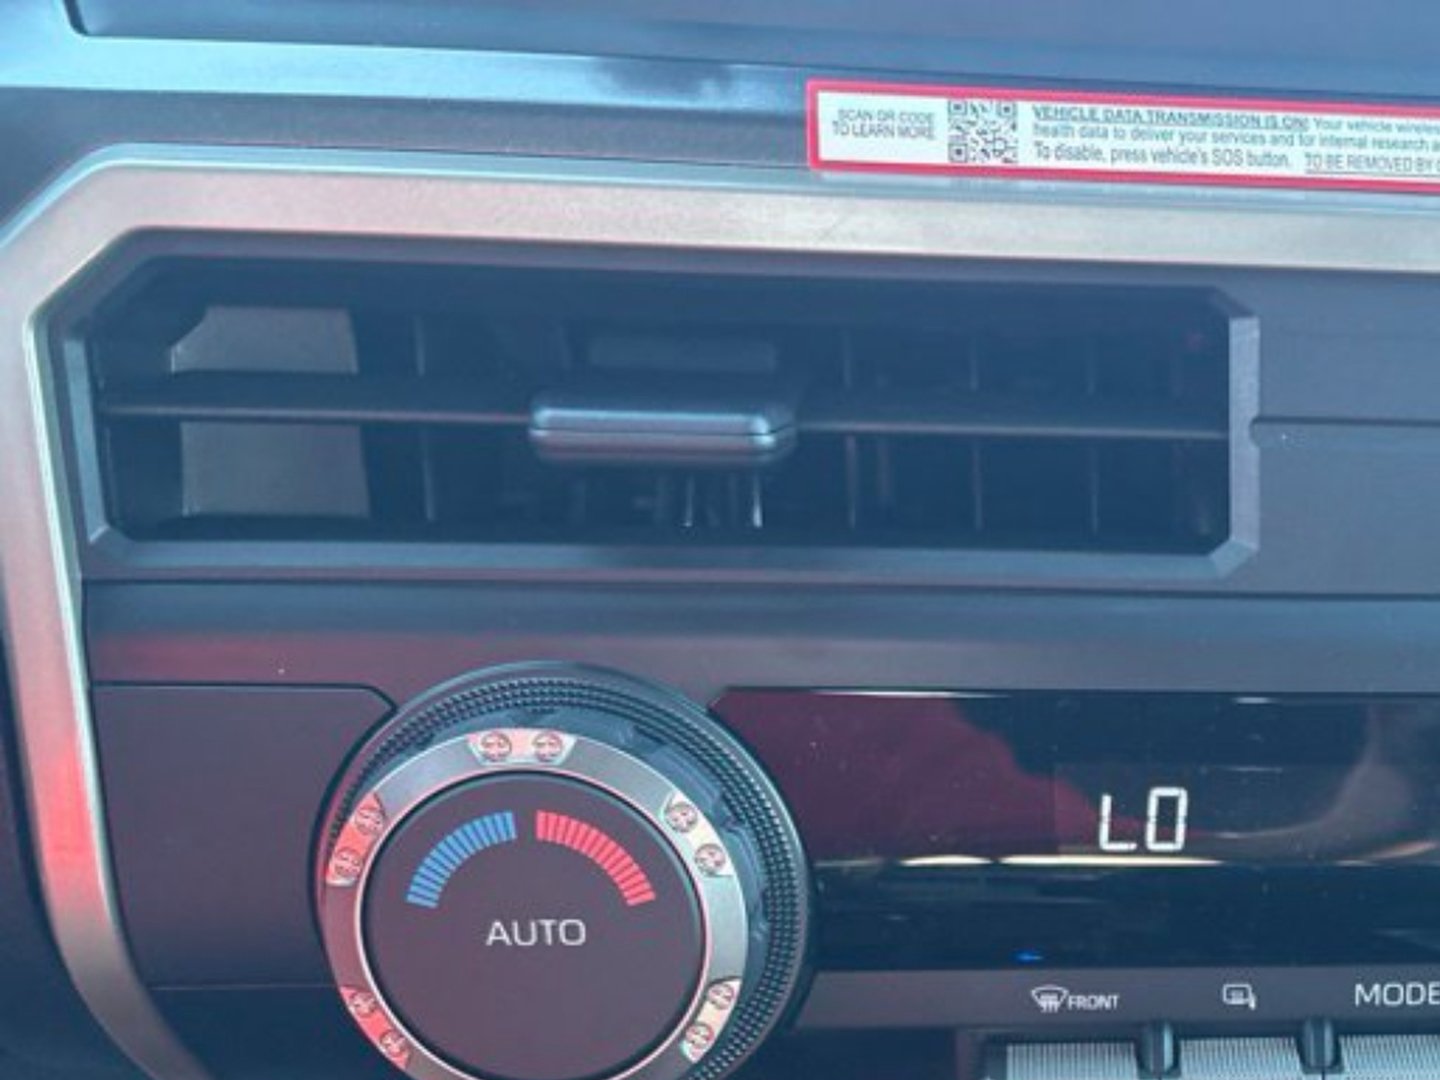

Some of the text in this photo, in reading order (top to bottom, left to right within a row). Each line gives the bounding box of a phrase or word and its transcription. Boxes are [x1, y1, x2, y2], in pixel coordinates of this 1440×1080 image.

[832, 120, 936, 140] TO LEARN MORE
[1031, 104, 1101, 122] VEHICLE
[1103, 108, 1144, 125] DATA
[1147, 109, 1261, 131] TRANSMISSION
[1263, 115, 1278, 130] IS
[1314, 117, 1344, 131] Your
[1346, 118, 1393, 132] vehicle
[1031, 122, 1076, 138] health
[1079, 125, 1110, 140] data
[1112, 126, 1127, 141] to
[1129, 128, 1174, 143] deliver
[1178, 131, 1208, 147] your
[1210, 130, 1267, 146] services
[1270, 133, 1295, 147] and
[1298, 134, 1318, 147] for
[1320, 135, 1368, 149] internal
[1371, 136, 1429, 151] research
[1032, 140, 1051, 160] To
[1109, 147, 1147, 165] press
[1149, 145, 1208, 166] vehicle's
[1210, 148, 1245, 168] SOS
[1304, 152, 1322, 169] TO
[1326, 153, 1345, 170] BE
[1347, 154, 1413, 174] REMOVED
[1416, 157, 1434, 174] BY
[1100, 786, 1188, 852] LO
[485, 918, 588, 947] AUTO
[1067, 994, 1119, 1011] FRONT
